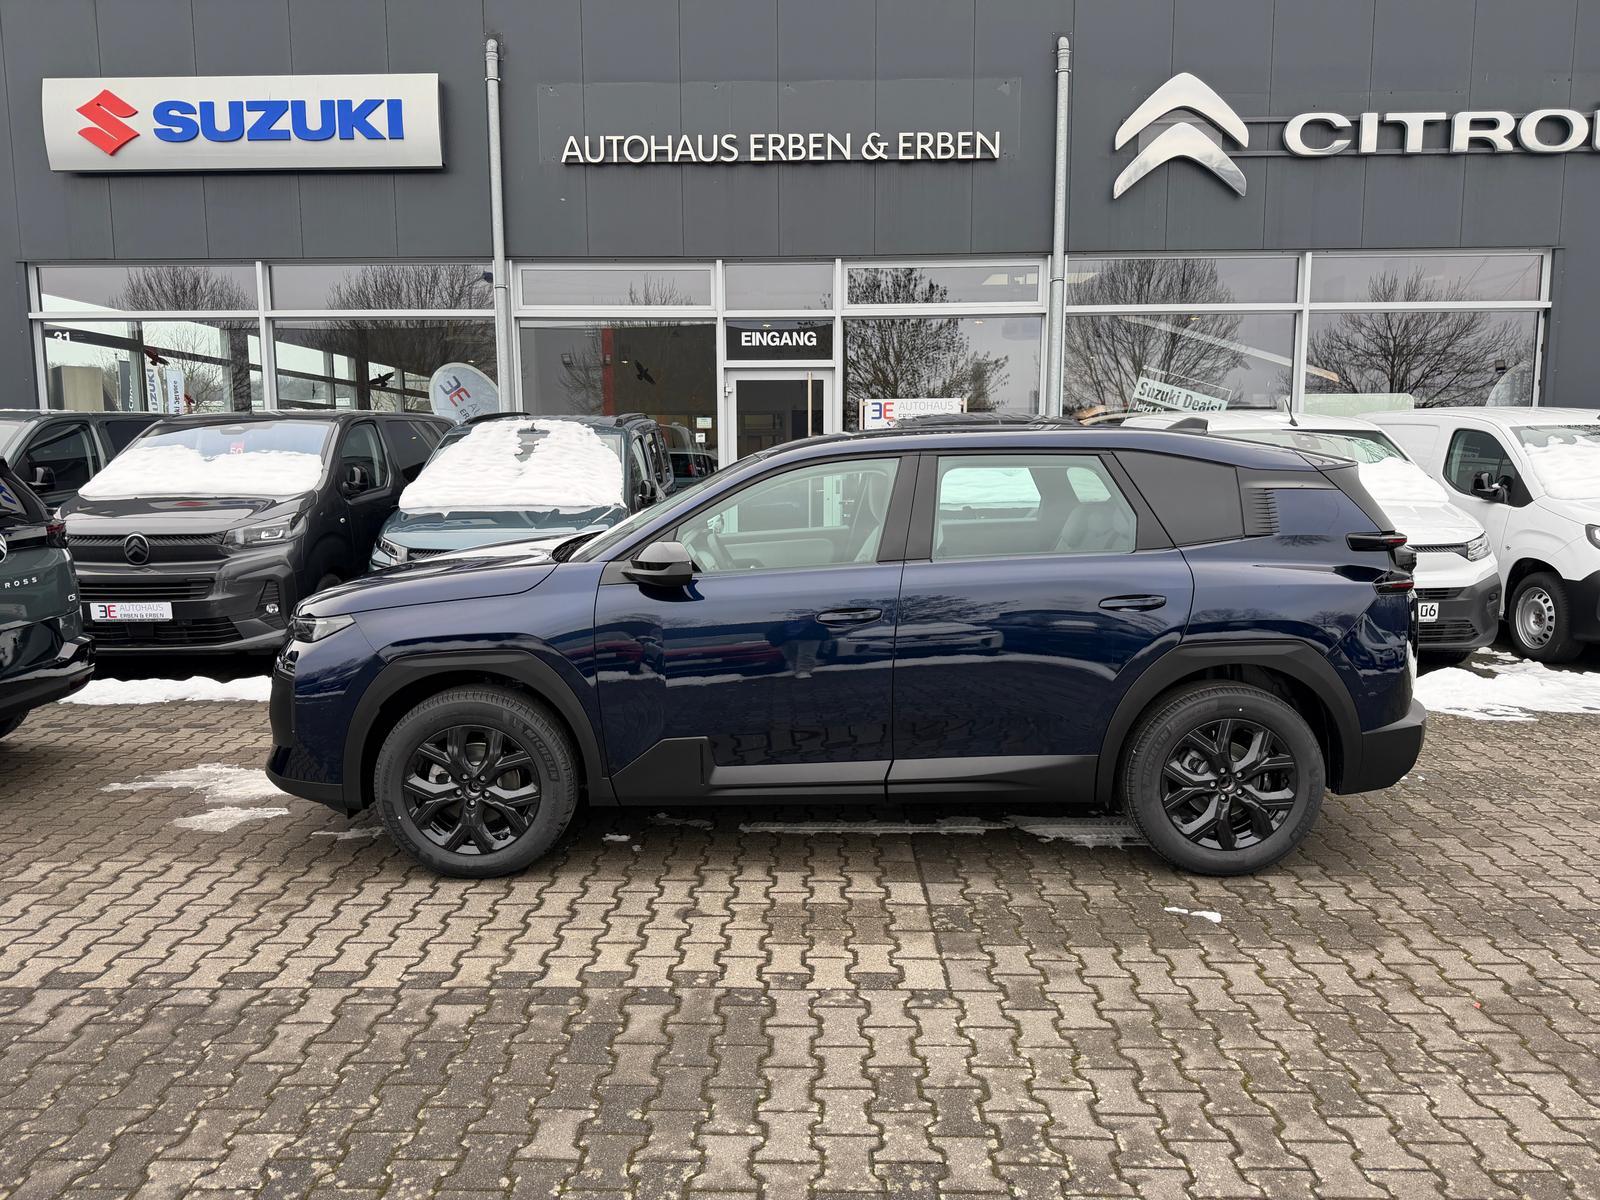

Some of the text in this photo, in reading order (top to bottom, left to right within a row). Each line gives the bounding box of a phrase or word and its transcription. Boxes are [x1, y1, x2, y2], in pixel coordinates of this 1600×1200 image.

[152, 99, 405, 143] SUZUKI
[1283, 109, 1600, 157] CITRO
[561, 131, 1000, 164] AUTOHAUS ERBEN & ERBEN
[741, 331, 817, 346] EINGANG
[147, 368, 159, 412] UZUKI
[1139, 381, 1182, 406] Suzuki
[899, 401, 954, 411] AUTOHAUS
[120, 604, 164, 612] AUTOHAUS
[1421, 604, 1436, 617] 06
